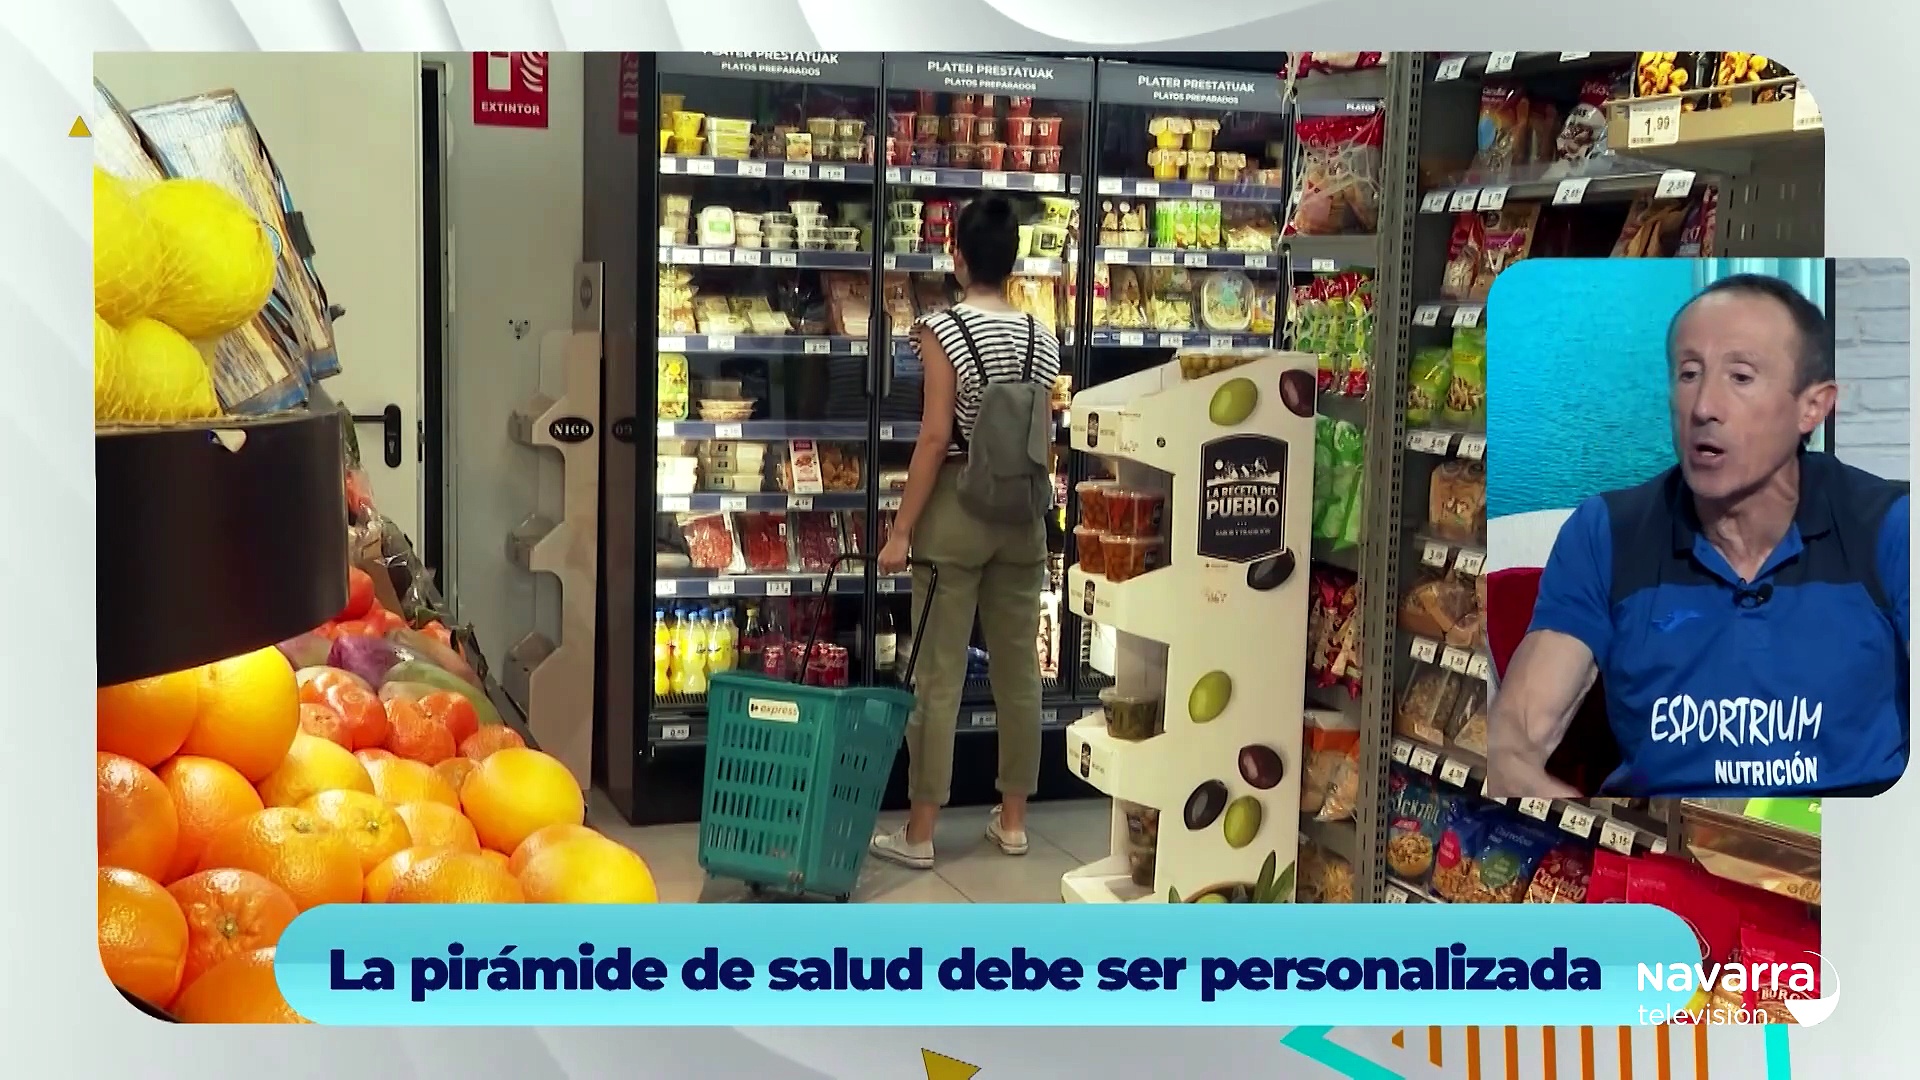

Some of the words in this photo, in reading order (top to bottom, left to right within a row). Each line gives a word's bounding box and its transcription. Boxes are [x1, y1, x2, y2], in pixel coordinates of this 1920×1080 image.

[756, 52, 839, 64] PRESTATUAK
[721, 61, 757, 72] PLATOS
[759, 64, 821, 76] PREPARADOS
[927, 60, 973, 74] PLATER
[976, 63, 1054, 79] PRESTATUAK
[944, 77, 978, 88] PLATOS
[979, 79, 1037, 90] PREPARADOS
[1138, 75, 1181, 88] PLATER
[1183, 78, 1255, 93] PRESTATUAK
[1153, 91, 1184, 101] PLATOS
[1185, 93, 1239, 104] PREPARADOS
[481, 101, 541, 115] EXTINTOR
[1346, 103, 1376, 112] PLATOS
[1645, 115, 1670, 135] 1.99
[553, 424, 590, 435] NICO
[1207, 488, 1219, 498] LA
[1222, 485, 1258, 496] RECETA
[1260, 485, 1277, 497] DEL
[1206, 497, 1280, 520] PUEBLO
[760, 704, 798, 716] express
[1650, 694, 1823, 748] ESPORTRIUM
[1714, 750, 1818, 787] NUTRICIÓN
[1609, 832, 1627, 847] 3.15
